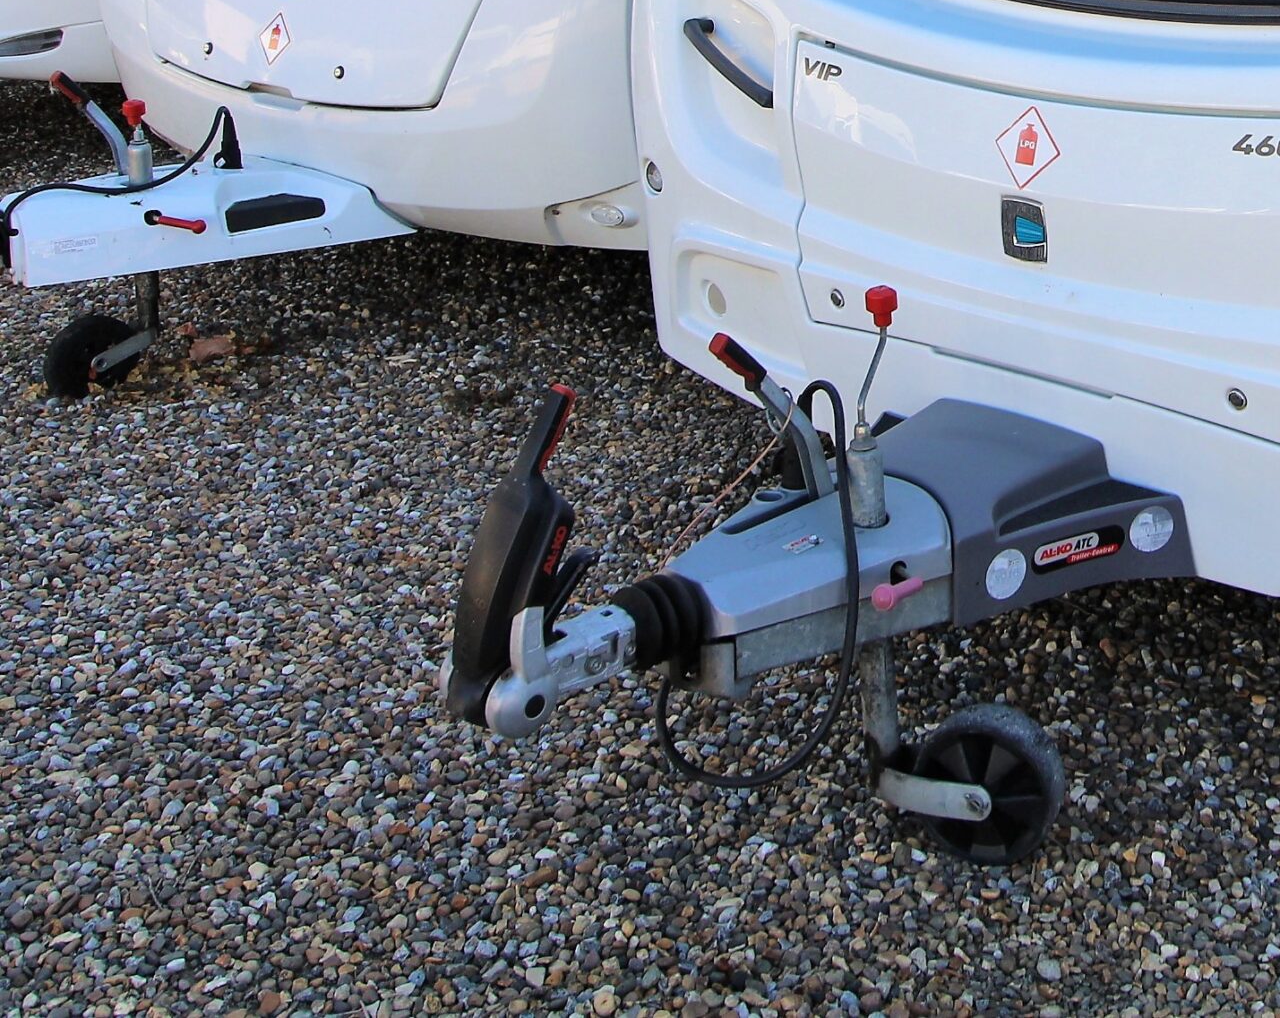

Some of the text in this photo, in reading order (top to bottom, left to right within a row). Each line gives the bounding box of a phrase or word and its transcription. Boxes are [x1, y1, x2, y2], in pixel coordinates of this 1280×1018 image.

[804, 57, 843, 82] VIP
[1019, 138, 1036, 150] LPG
[1073, 535, 1094, 552] ATC
